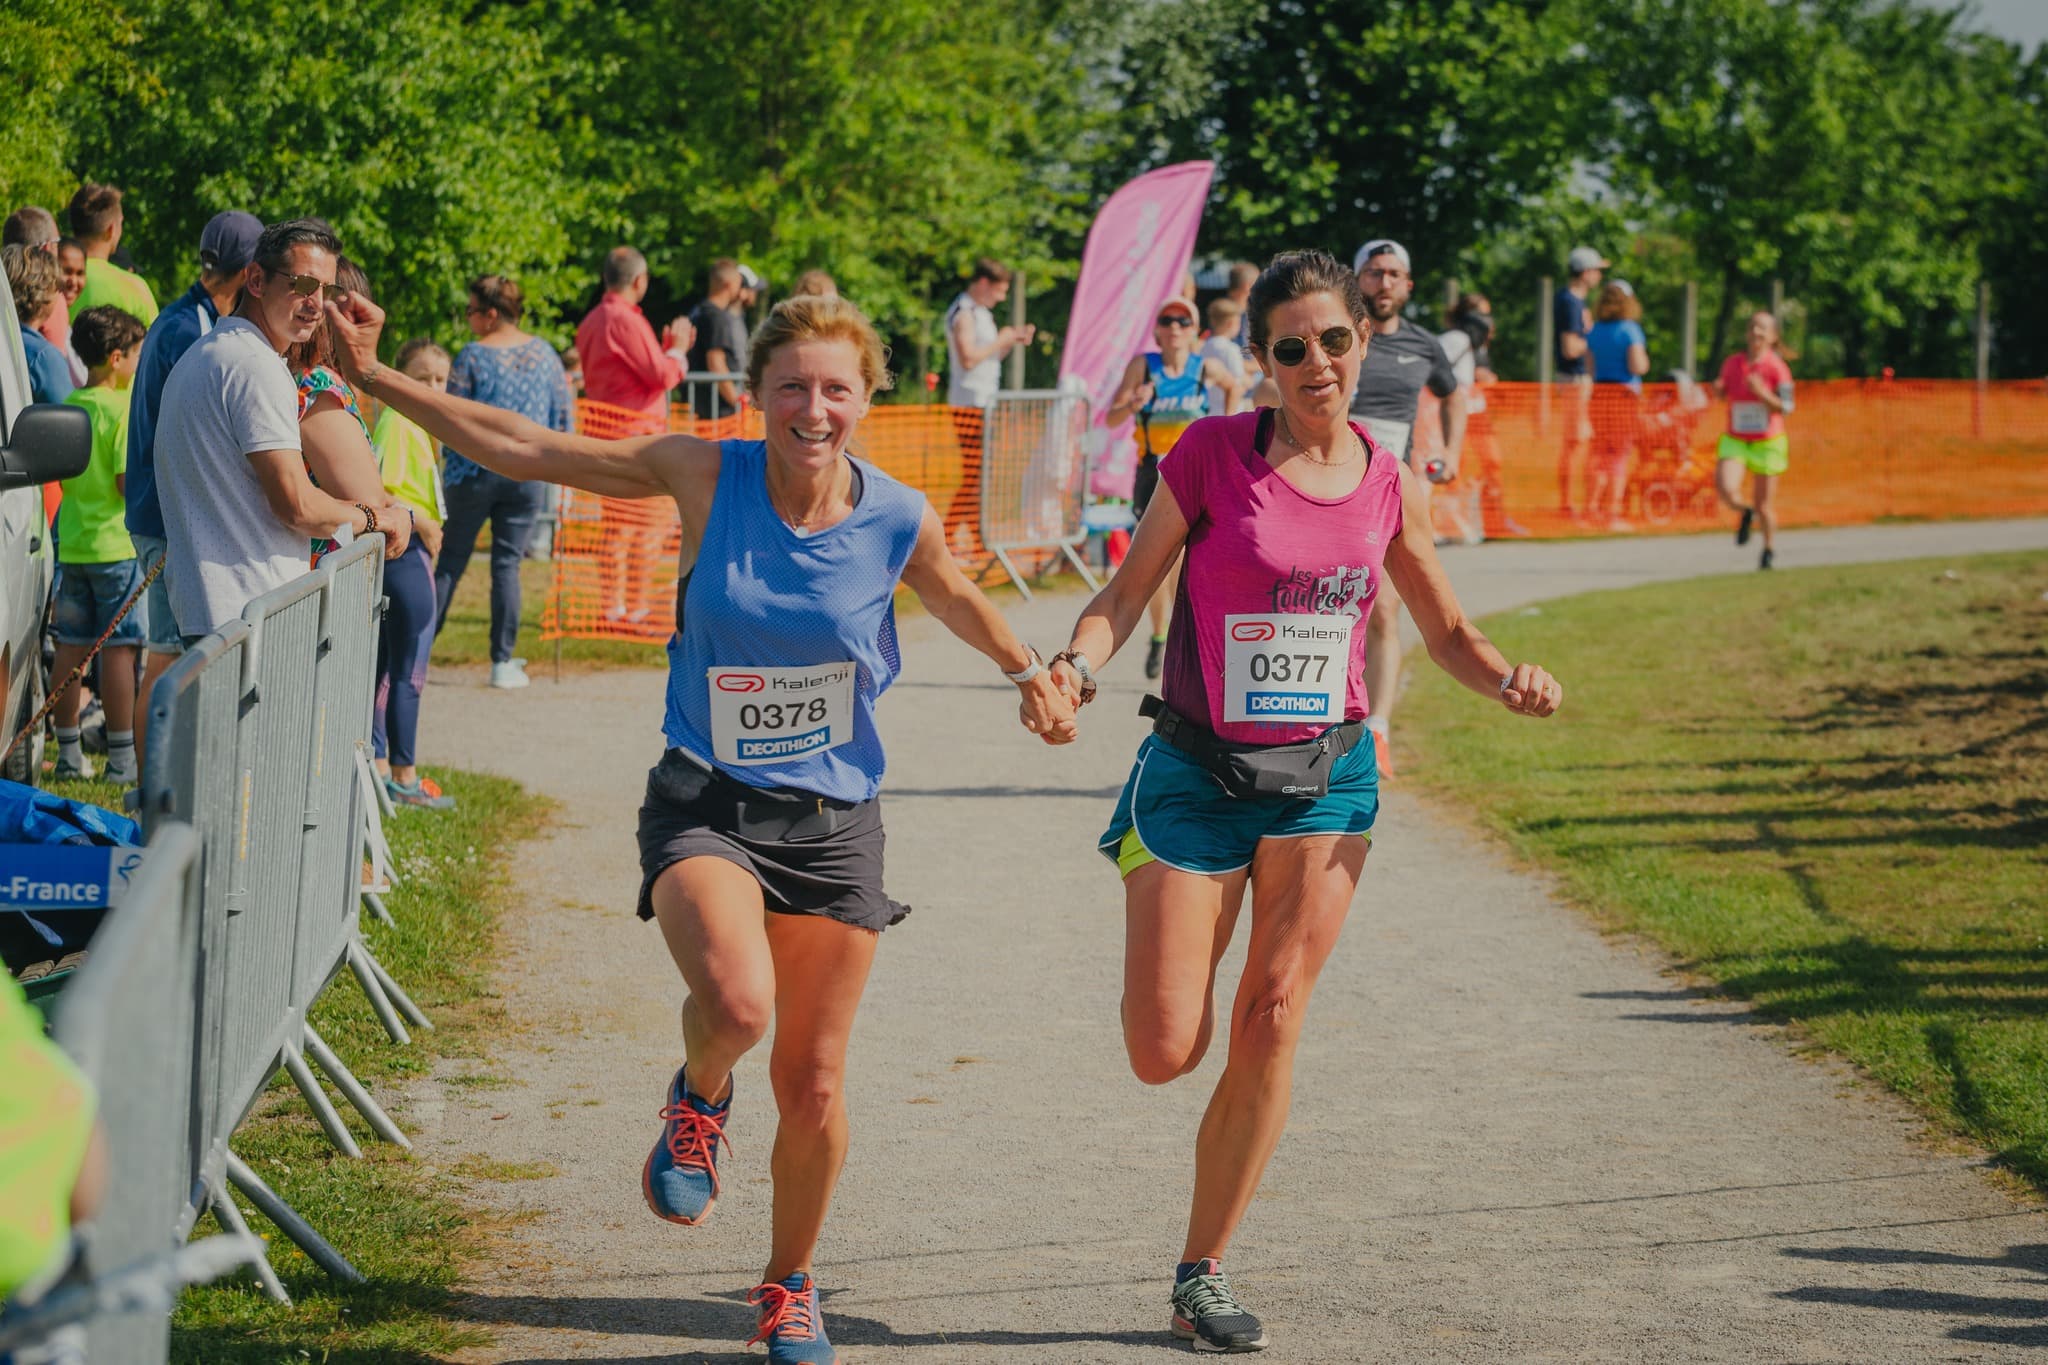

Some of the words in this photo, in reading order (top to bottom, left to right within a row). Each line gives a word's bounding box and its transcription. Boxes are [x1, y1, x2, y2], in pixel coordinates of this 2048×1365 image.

[1282, 624, 1348, 645] Kalenji
[772, 666, 849, 690] Kalenji
[1250, 653, 1330, 683] 0377
[739, 697, 828, 731] 0378
[1251, 696, 1326, 712] DECATHLON
[742, 730, 827, 756] DECATHLON
